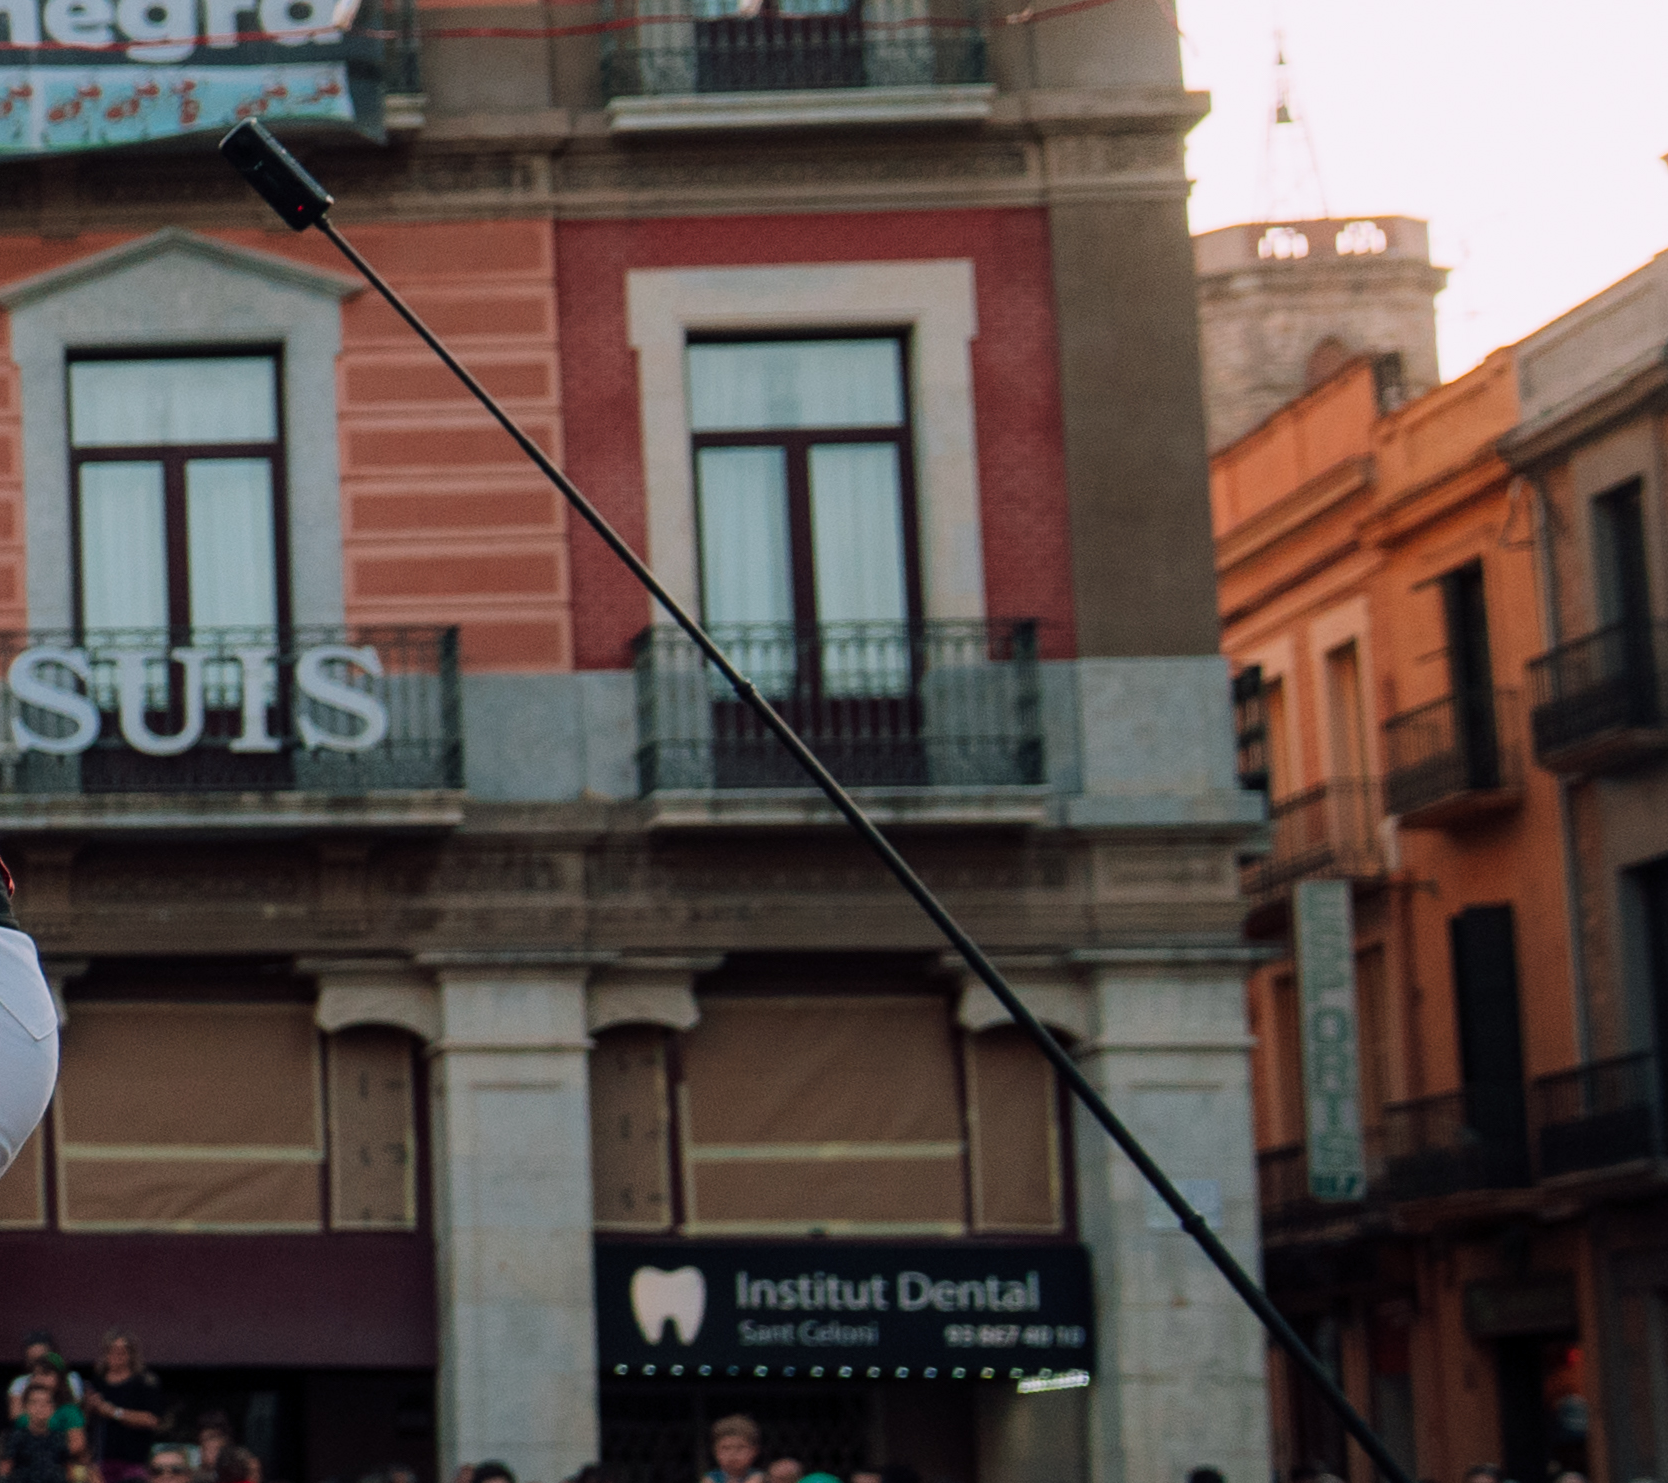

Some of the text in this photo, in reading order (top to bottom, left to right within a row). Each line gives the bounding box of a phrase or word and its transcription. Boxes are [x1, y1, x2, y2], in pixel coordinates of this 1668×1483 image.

[7, 644, 388, 757] SUIS
[735, 1271, 1041, 1313] Institut Dental
[799, 1319, 880, 1347] Celoni
